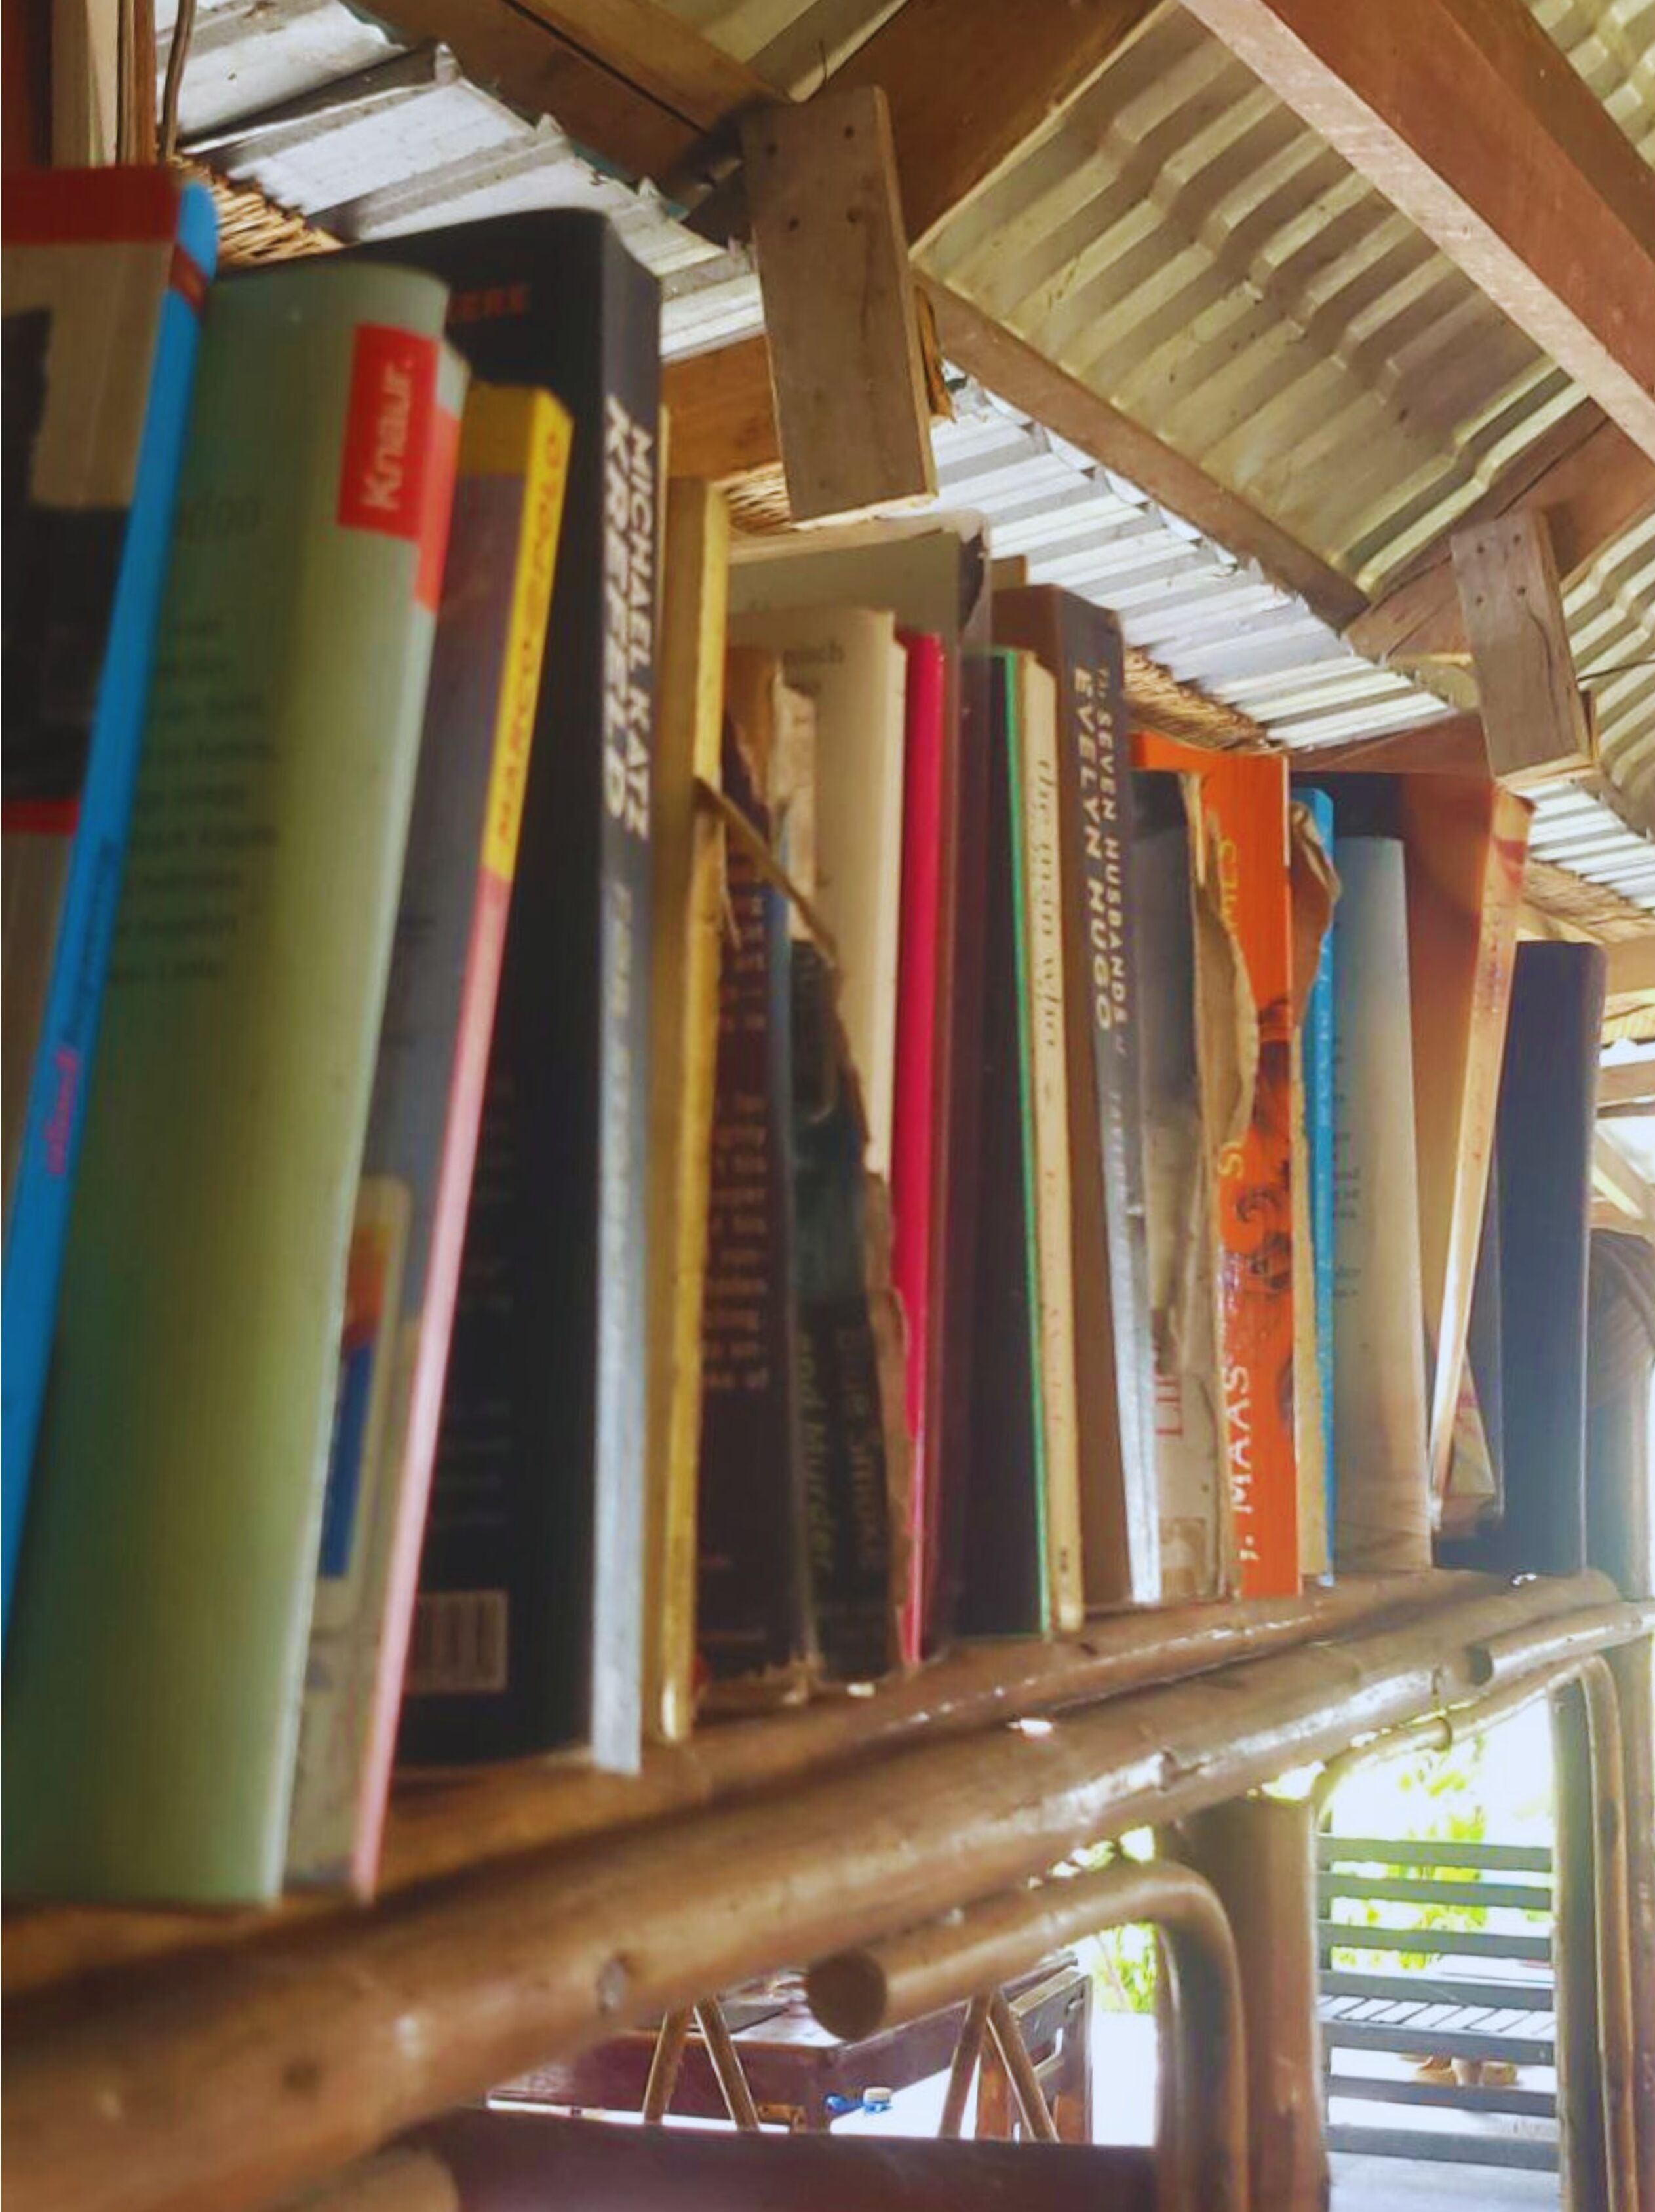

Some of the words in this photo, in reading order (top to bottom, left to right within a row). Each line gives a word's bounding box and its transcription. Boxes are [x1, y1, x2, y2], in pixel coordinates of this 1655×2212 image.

[604, 393, 629, 819] KREFELD
[629, 423, 654, 674] MICHAEL
[626, 686, 653, 840] KATZ
[1074, 667, 1102, 861] EVELYN
[1097, 708, 1116, 821] SEVEN
[1087, 876, 1112, 1032] HUGO
[1103, 833, 1127, 1024] HUSBANDS
[1222, 1364, 1253, 1514] MAAS
